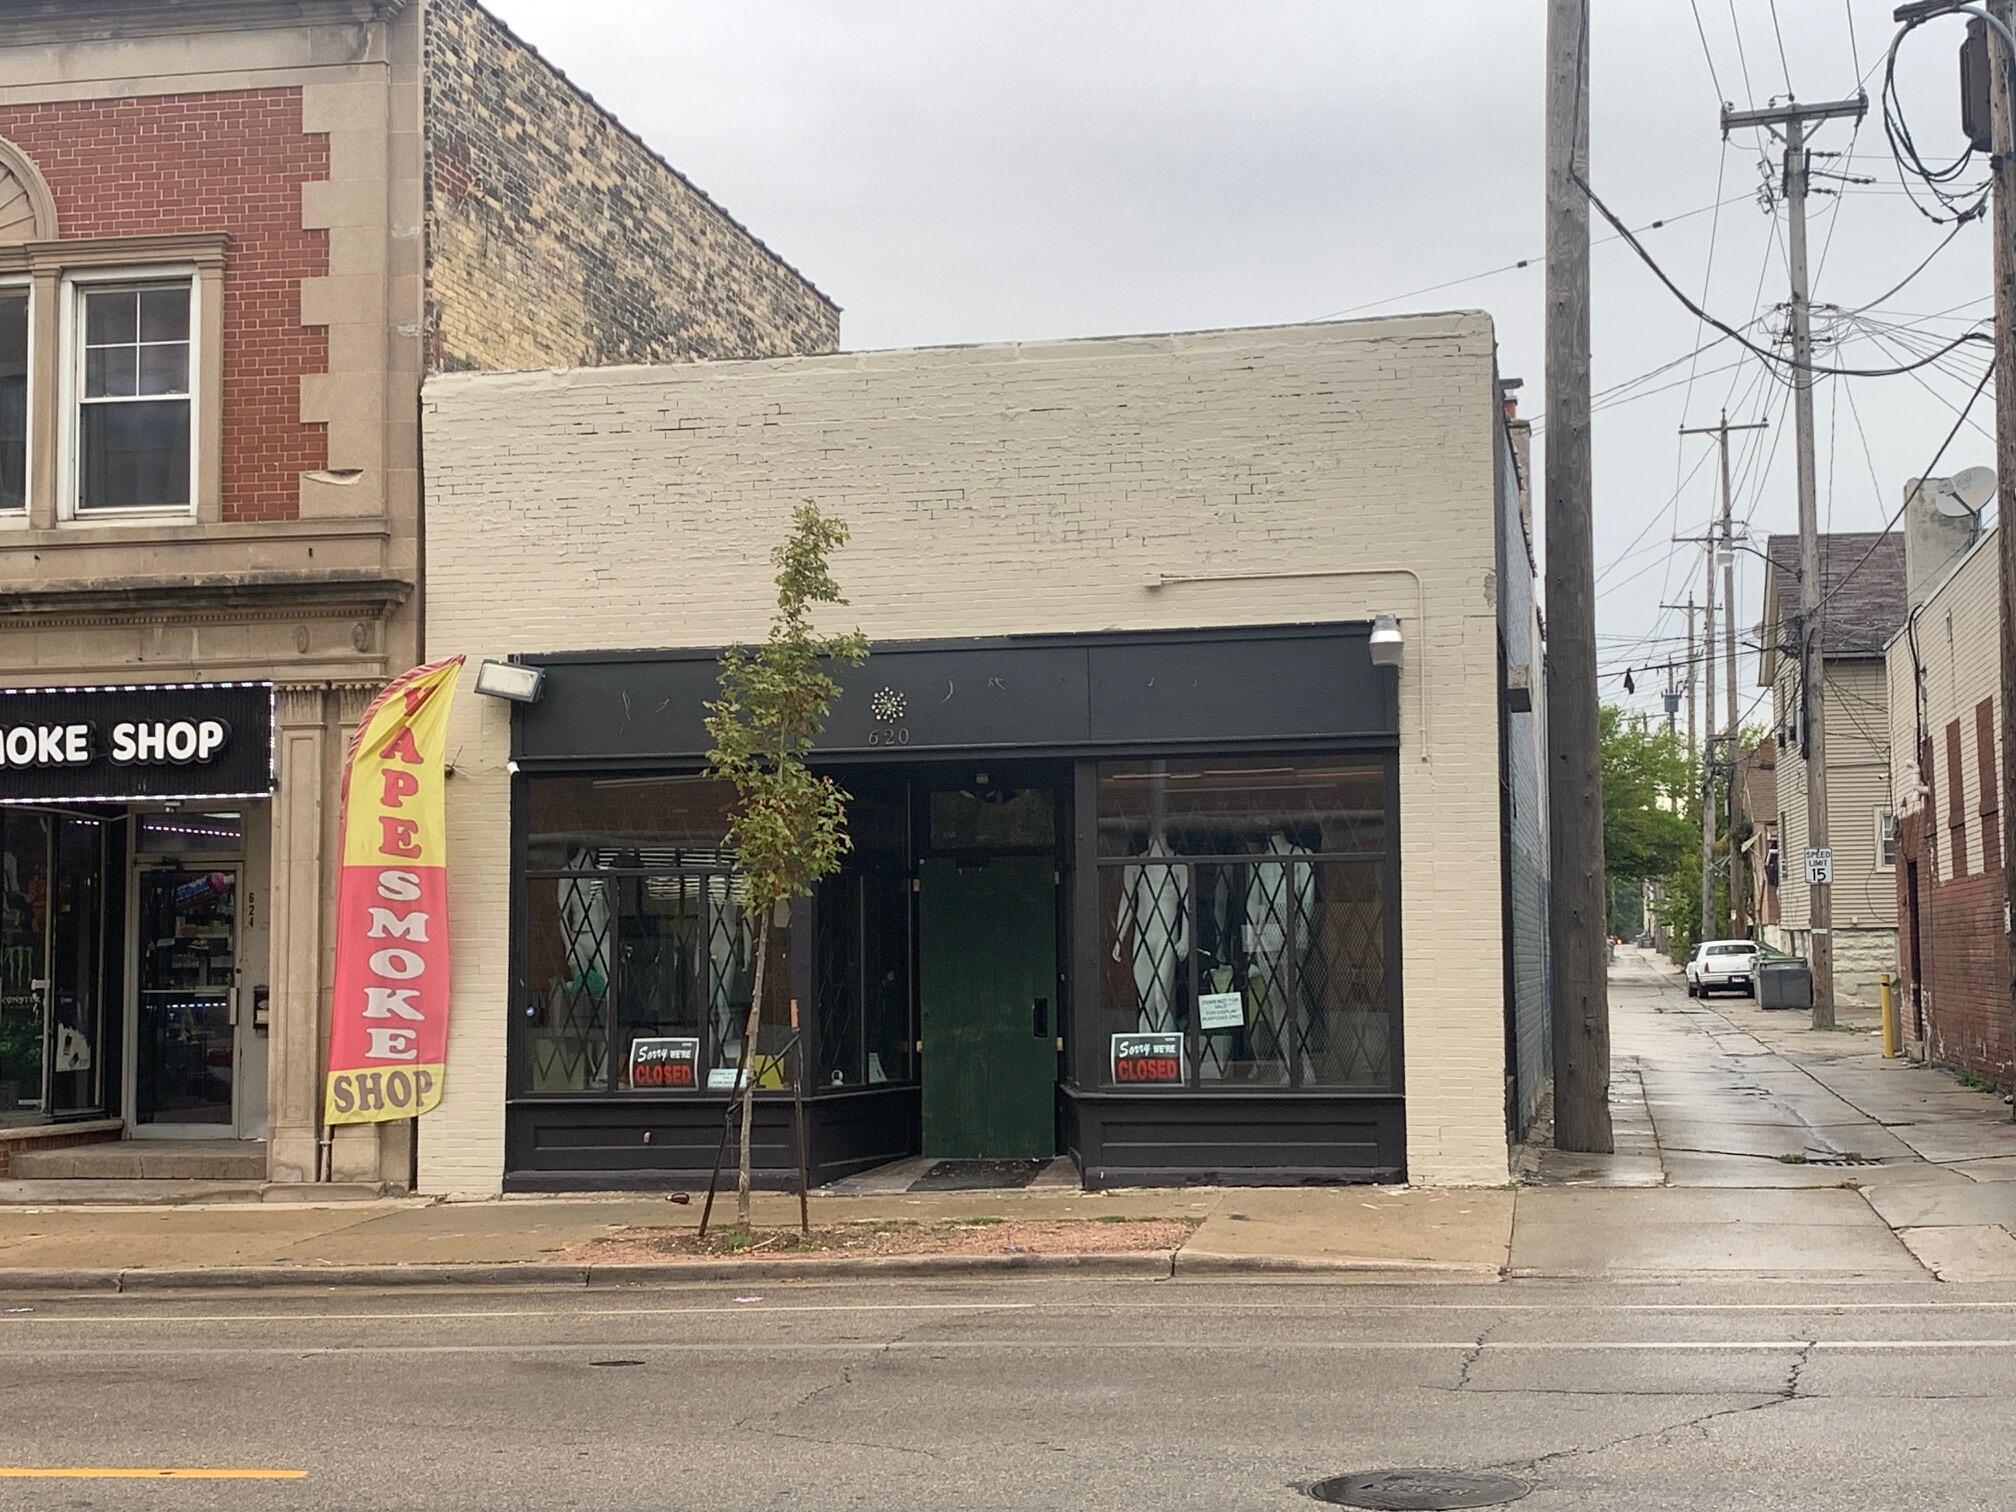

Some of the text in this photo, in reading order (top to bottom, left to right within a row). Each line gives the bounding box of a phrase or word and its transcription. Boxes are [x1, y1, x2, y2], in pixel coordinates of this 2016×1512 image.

[0, 721, 223, 765] OKE SHOP
[868, 728, 909, 746] 620
[379, 685, 438, 860] VAPE
[1806, 851, 1831, 859] SPEED
[1812, 868, 1827, 882] 15
[362, 870, 429, 1060] SMOKE
[637, 1046, 668, 1062] Sorry
[1119, 1041, 1150, 1058] Sorry
[635, 1065, 691, 1083] CLOSED
[1119, 1060, 1177, 1080] CLOSED
[333, 1070, 433, 1113] SHOP
